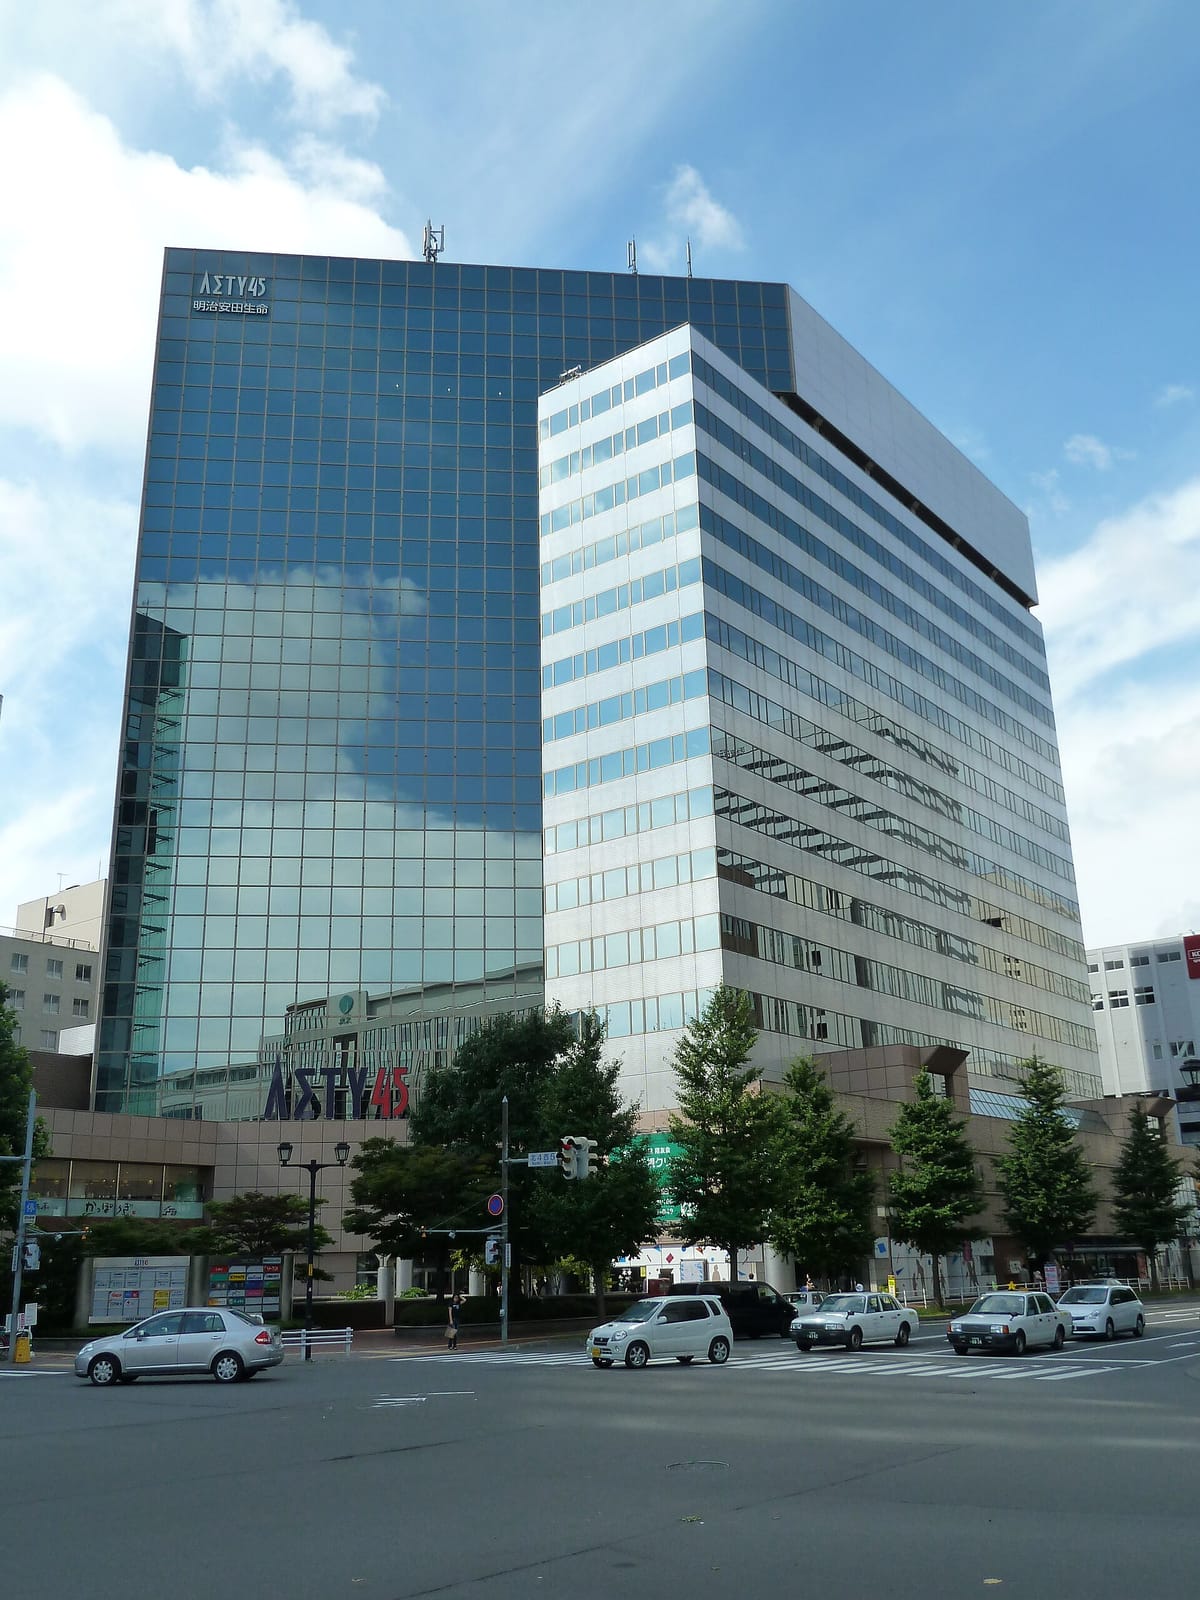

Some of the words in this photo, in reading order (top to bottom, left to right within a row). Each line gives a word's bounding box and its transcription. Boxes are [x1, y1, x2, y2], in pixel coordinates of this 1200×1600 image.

[193, 300, 269, 314] 明治安田生命
